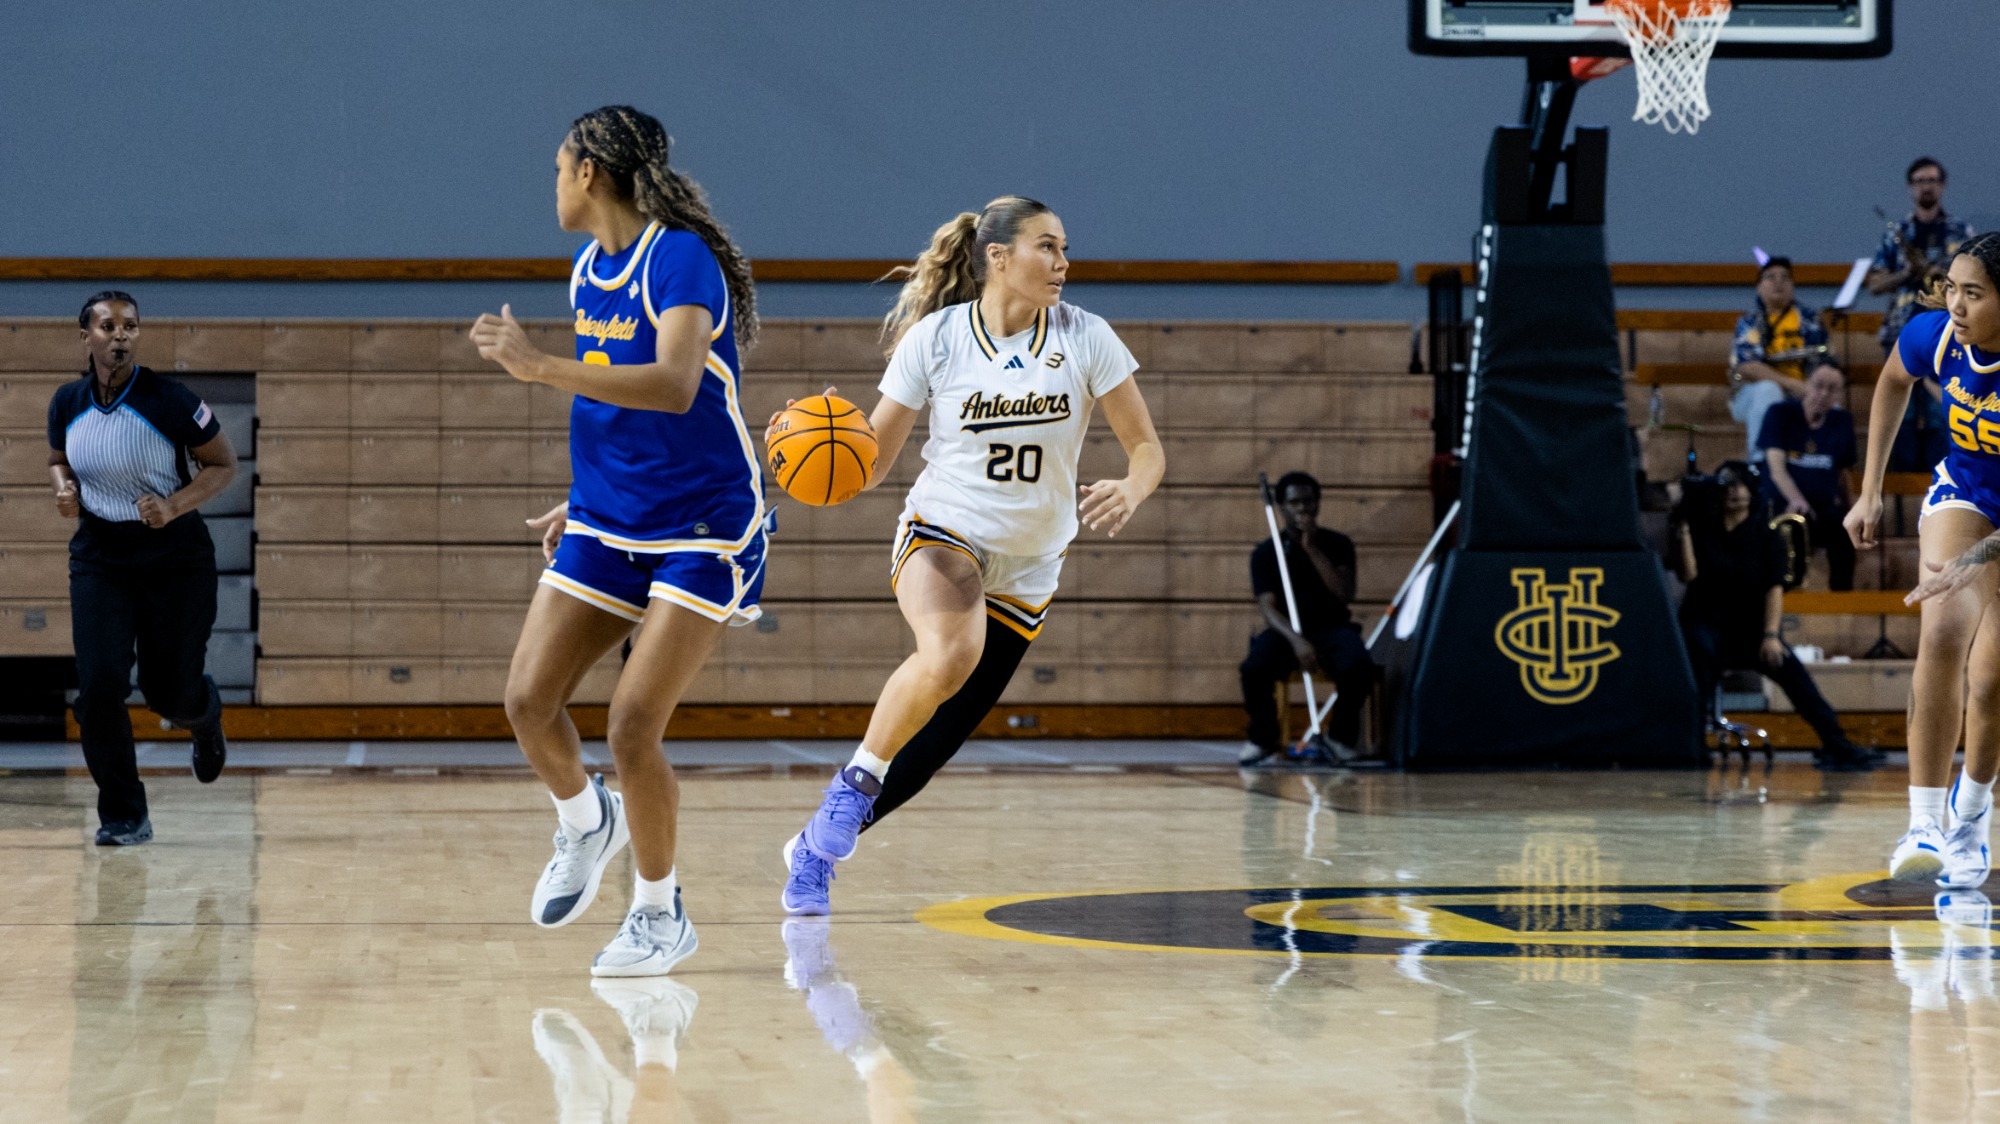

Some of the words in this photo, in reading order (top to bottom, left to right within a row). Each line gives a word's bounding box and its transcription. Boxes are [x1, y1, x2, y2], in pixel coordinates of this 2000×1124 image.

[959, 391, 1071, 421] Anteaters
[1949, 403, 2000, 455] 55
[986, 443, 1043, 483] 20
